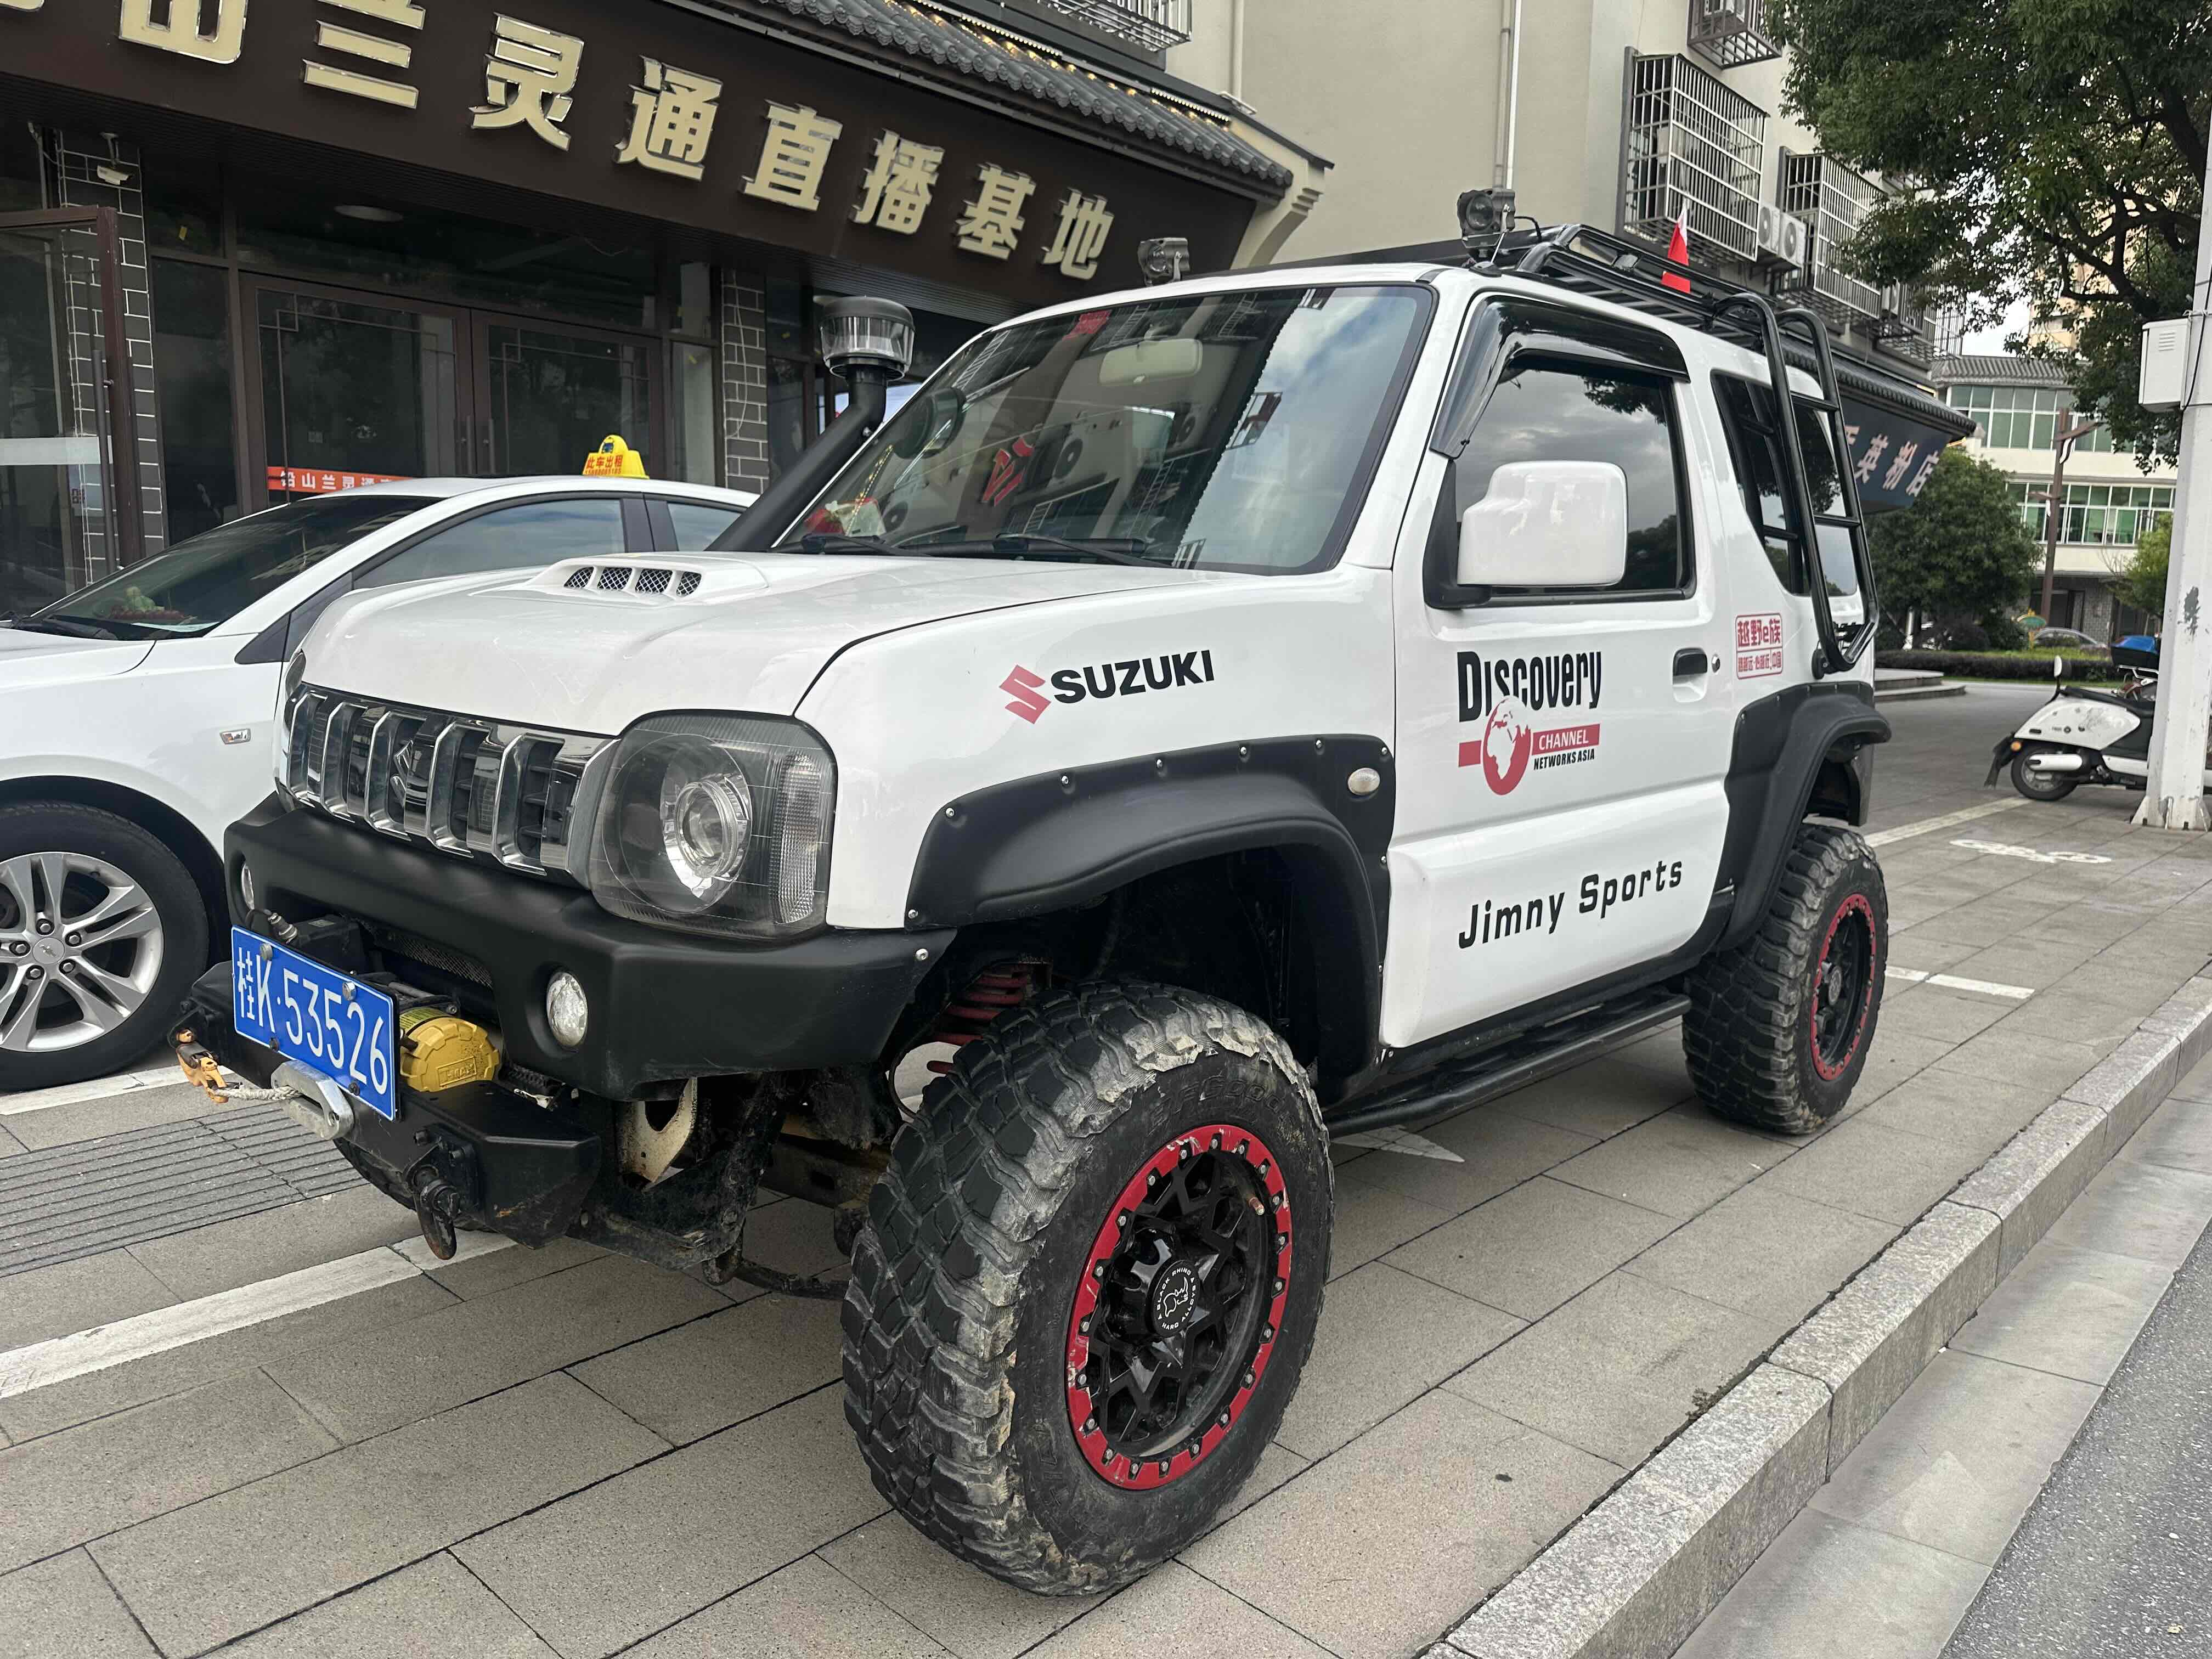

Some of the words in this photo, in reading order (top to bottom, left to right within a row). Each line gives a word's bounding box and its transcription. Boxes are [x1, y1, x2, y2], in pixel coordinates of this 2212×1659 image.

[586, 454, 623, 469] 此车出租
[1844, 426, 1940, 497] 英粉店
[1737, 618, 1781, 648] 越野e族
[1051, 650, 1215, 704] SUZUKI
[1457, 651, 1601, 723] Discovery
[1533, 752, 1576, 770] NETWORKS
[1577, 748, 1595, 763] ASIA
[1538, 729, 1589, 751] CHANNEL
[1458, 891, 1565, 949] Jimny
[1579, 860, 1682, 919] Sports
[1156, 1277, 1170, 1311] BLACK
[1172, 1267, 1192, 1276] RHINO
[1161, 1322, 1180, 1330] HARD
[1181, 1284, 1197, 1322] ALLOYS
